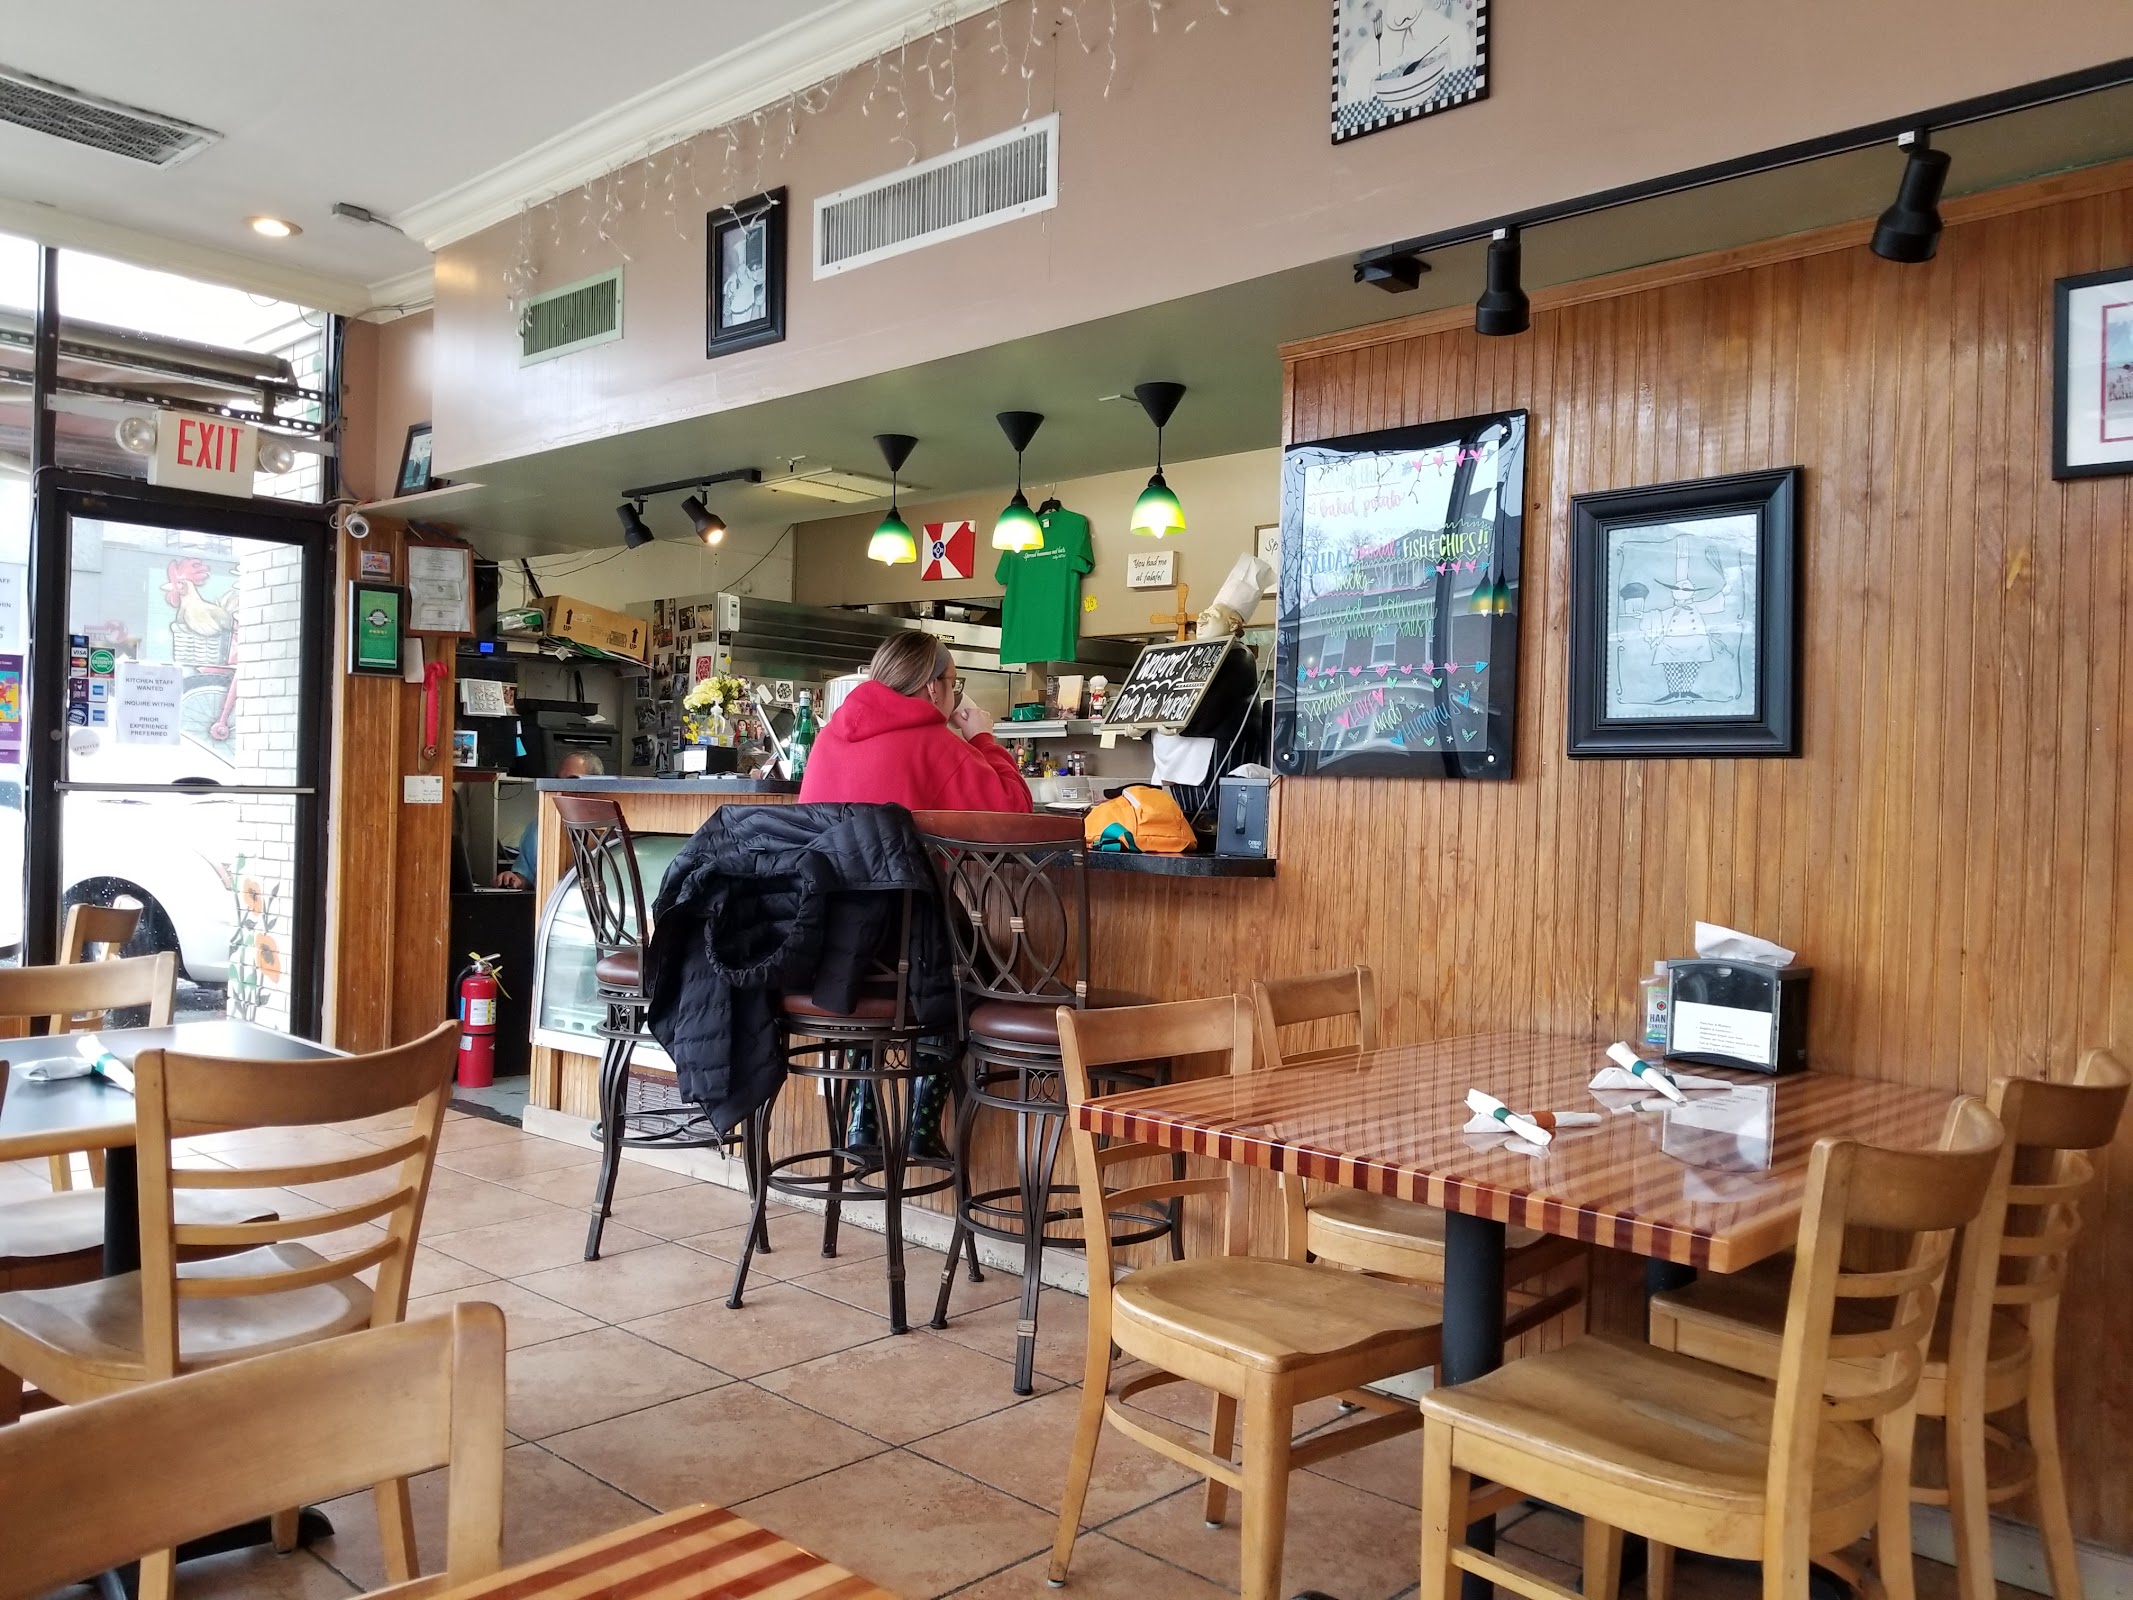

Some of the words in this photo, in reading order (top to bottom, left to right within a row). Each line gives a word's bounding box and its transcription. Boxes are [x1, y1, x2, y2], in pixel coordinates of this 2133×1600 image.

[177, 418, 244, 473] EXIT
[1320, 496, 1358, 518] baked
[1363, 490, 1405, 517] potato
[1133, 558, 1145, 569] You
[1146, 555, 1159, 567] had
[1158, 558, 1167, 566] me
[1303, 547, 1353, 575] FRIDAY
[1374, 560, 1431, 587] SPECIAL
[1136, 573, 1143, 582] at
[1143, 570, 1164, 584] falafel
[1373, 595, 1438, 619] salmon
[563, 624, 572, 632] UP
[1136, 646, 1194, 681] Welcome!
[1134, 692, 1161, 723] Seat
[1303, 674, 1352, 725] spread
[1348, 693, 1378, 726] LOVE
[1372, 699, 1403, 734] and
[1402, 692, 1462, 742] HUMMUS
